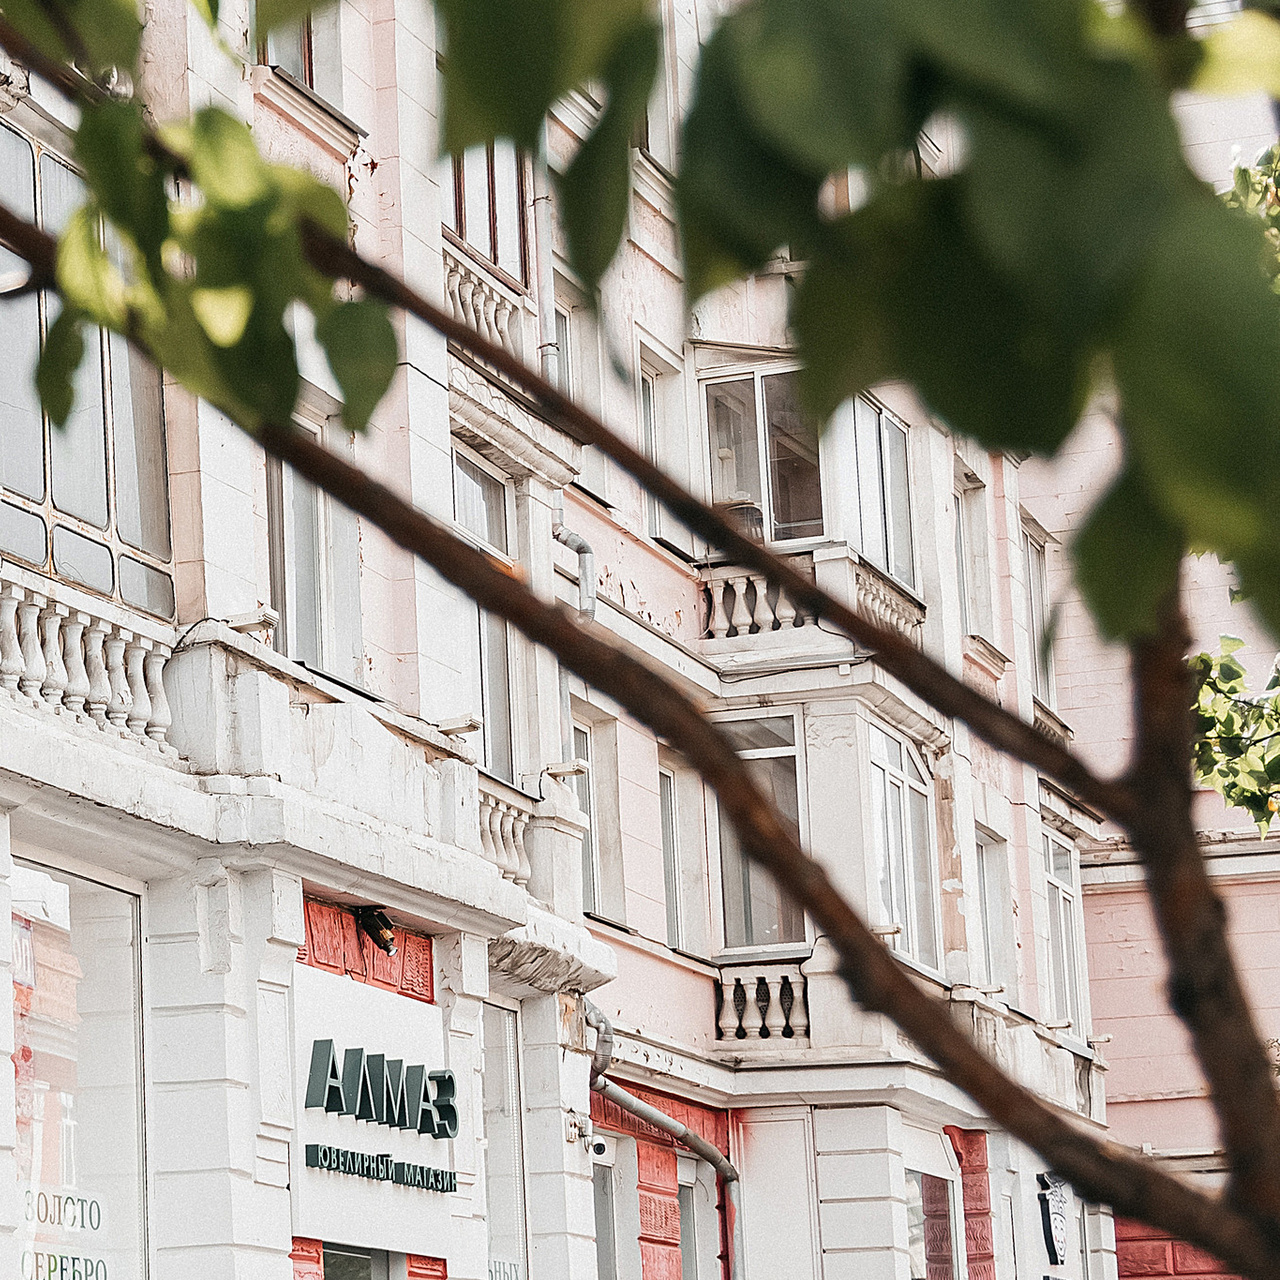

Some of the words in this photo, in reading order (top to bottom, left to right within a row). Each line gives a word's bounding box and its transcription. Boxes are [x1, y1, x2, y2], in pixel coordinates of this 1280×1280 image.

[305, 1038, 460, 1139] АЛМАЗ
[308, 1144, 396, 1182] ЮВЕЛИРНЫЙ
[399, 1162, 458, 1193] МАГАЗИН
